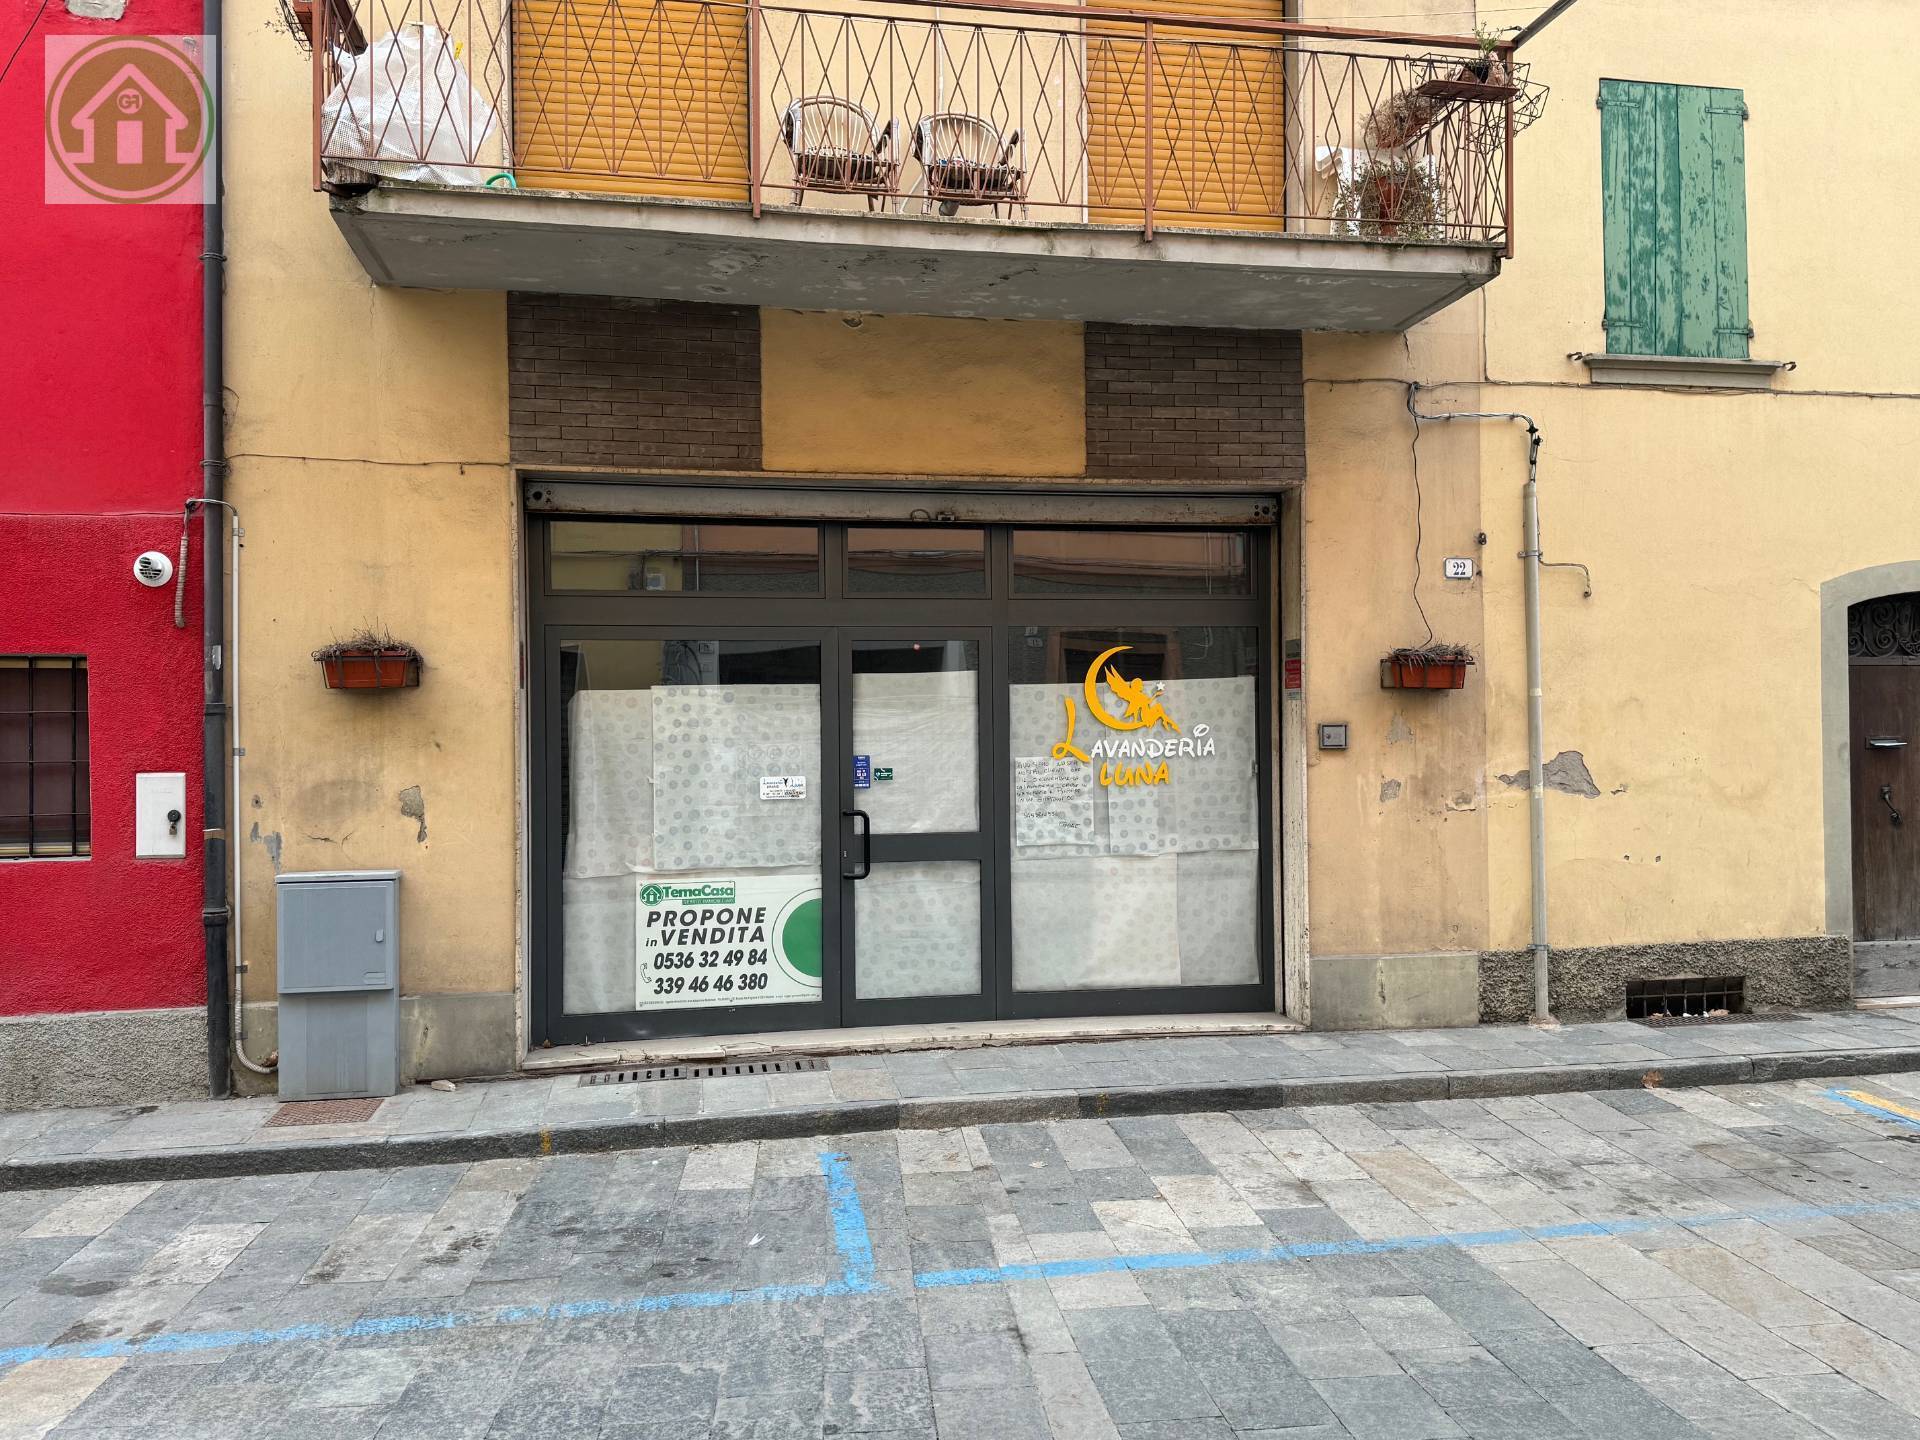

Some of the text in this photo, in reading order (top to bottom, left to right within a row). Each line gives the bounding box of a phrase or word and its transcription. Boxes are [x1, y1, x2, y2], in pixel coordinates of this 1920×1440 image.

[1453, 561, 1466, 576] 22
[1051, 697, 1216, 763] LAVANDERIA
[1100, 760, 1169, 786] LUNA
[662, 884, 734, 898] TemaCasa
[646, 907, 767, 927] PROPONE
[645, 926, 765, 947] in VENDITA
[653, 948, 768, 970] 0536 32 49 84
[653, 973, 768, 995] 339 46 46 380
